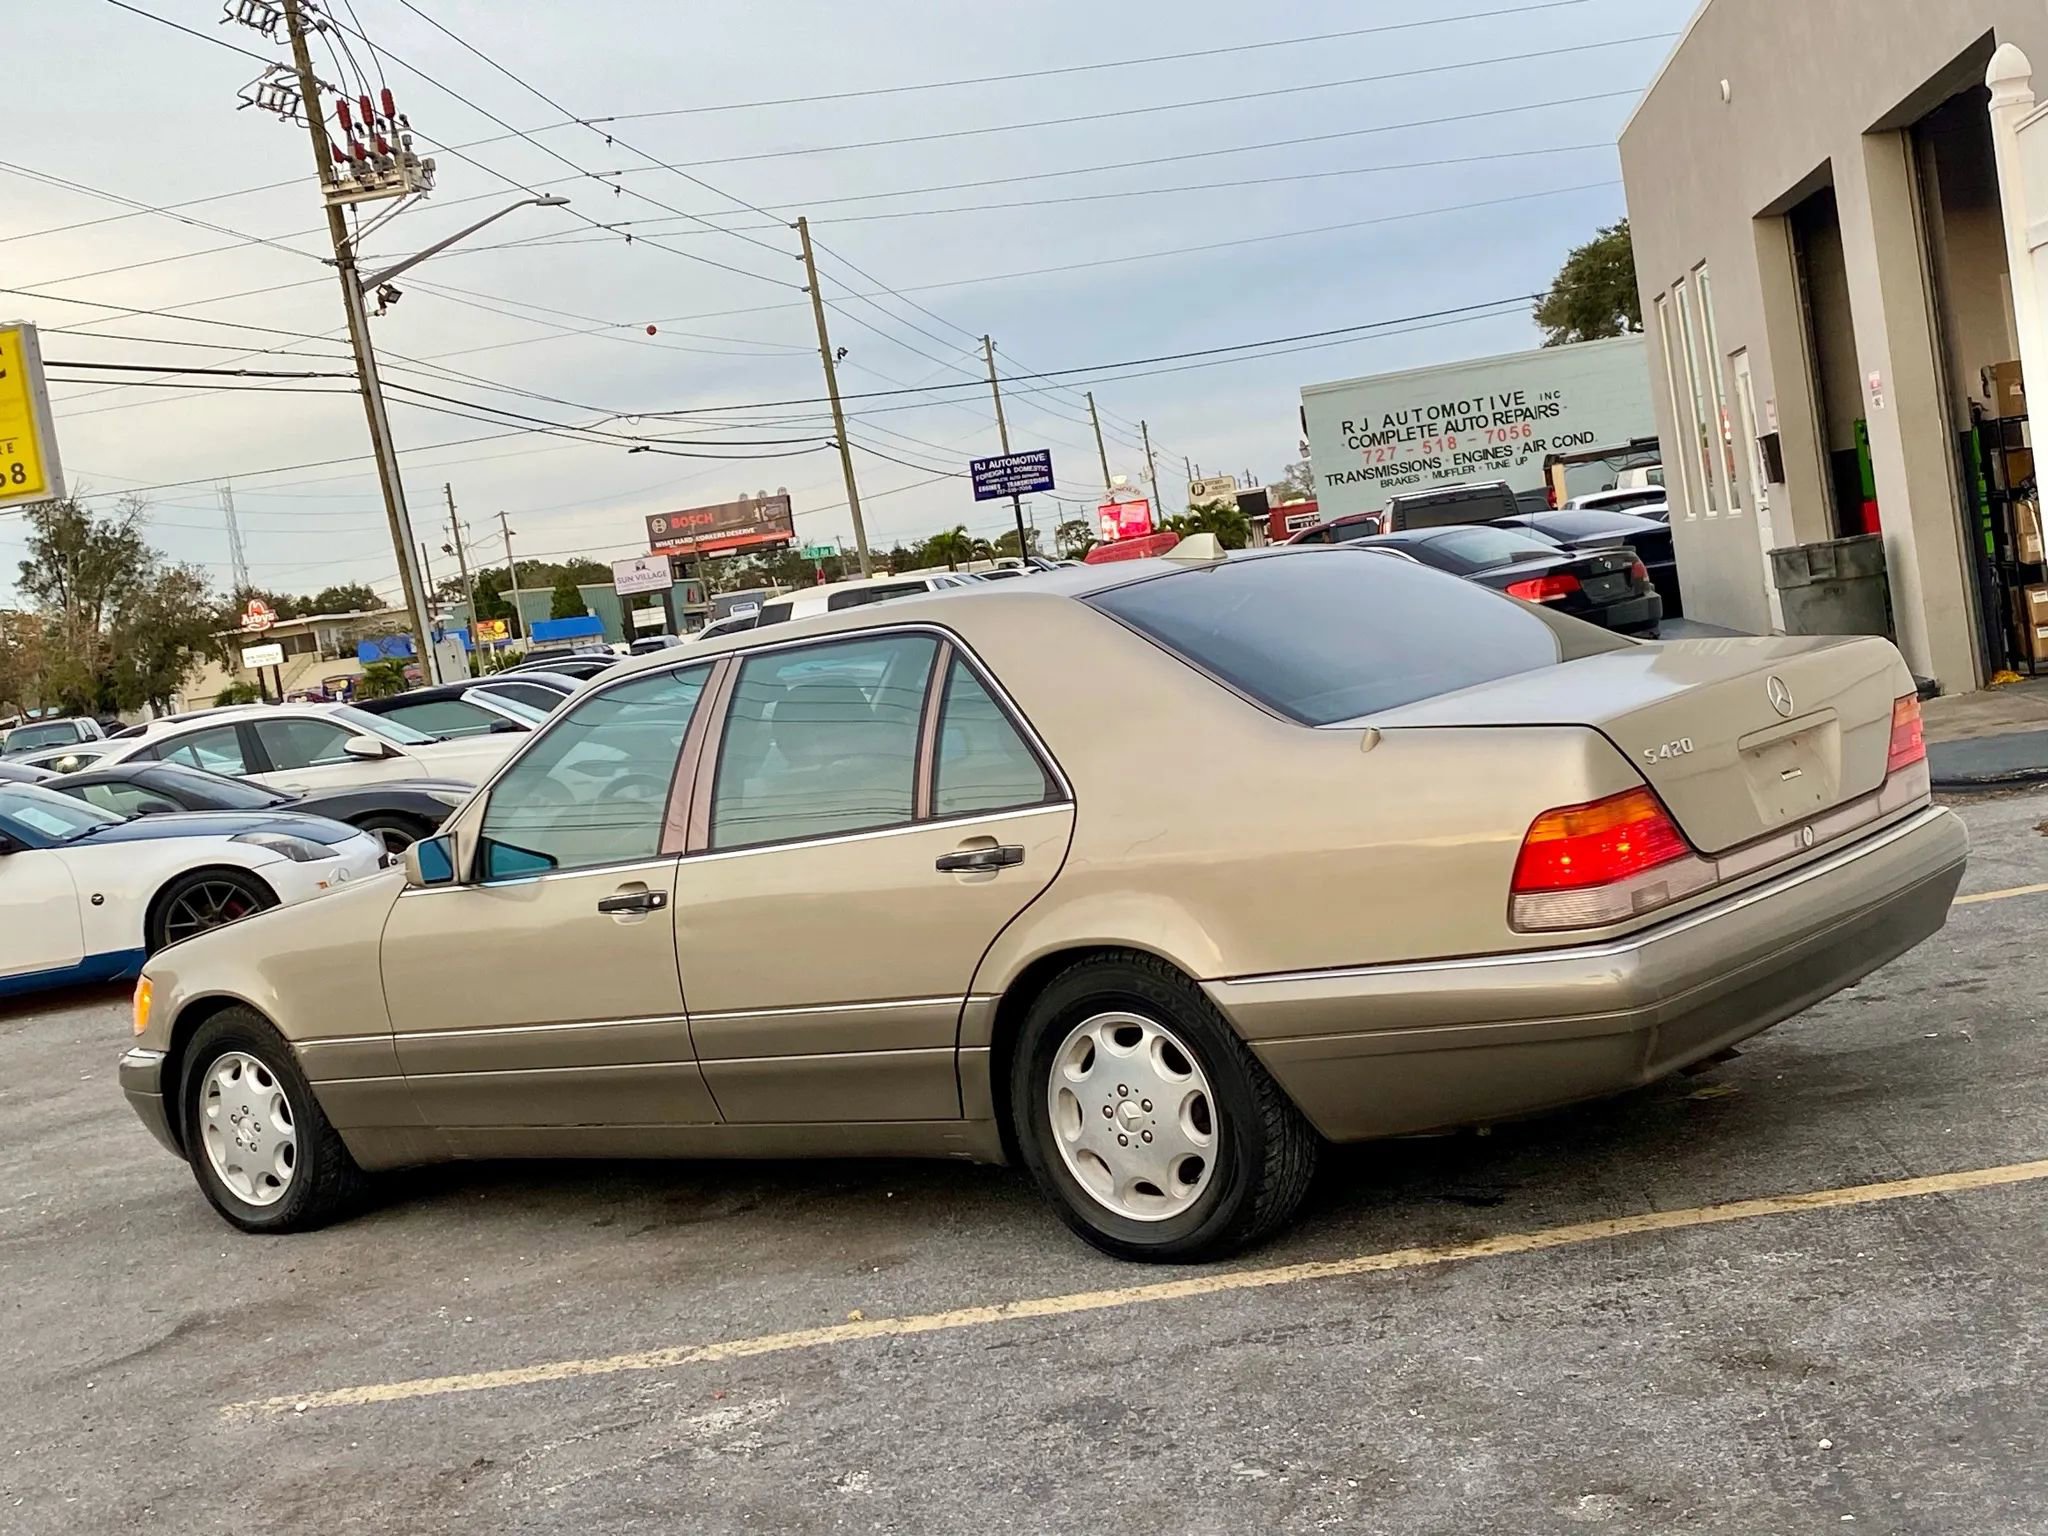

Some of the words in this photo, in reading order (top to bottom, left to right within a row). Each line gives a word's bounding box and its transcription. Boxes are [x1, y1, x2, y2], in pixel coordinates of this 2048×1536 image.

[1341, 418, 1369, 435] RJ
[1382, 391, 1526, 428] AUTOMOTIVE
[1539, 391, 1561, 401] INC
[1348, 423, 1439, 449] COMPLETE
[1444, 414, 1489, 435] AUTO
[1493, 402, 1560, 426] REPAIRS
[974, 461, 986, 471] RJ
[989, 453, 1045, 469] AUTOMOTIVE
[1325, 456, 1442, 486] TRANSMISSIONS
[1453, 445, 1513, 466] ENGINES
[1521, 439, 1547, 455] AIR
[975, 469, 1005, 482] FOREIGN
[1013, 465, 1049, 473] DOMESTIC
[1380, 474, 1420, 488] BRAKES
[1432, 464, 1476, 480] MUFFLER
[1485, 461, 1511, 472] TUNE
[1515, 456, 1528, 467] UP
[671, 512, 713, 529] BOSCH
[655, 538, 675, 548] WHAT
[617, 575, 634, 584] SUN
[635, 570, 668, 581] VILLAGE
